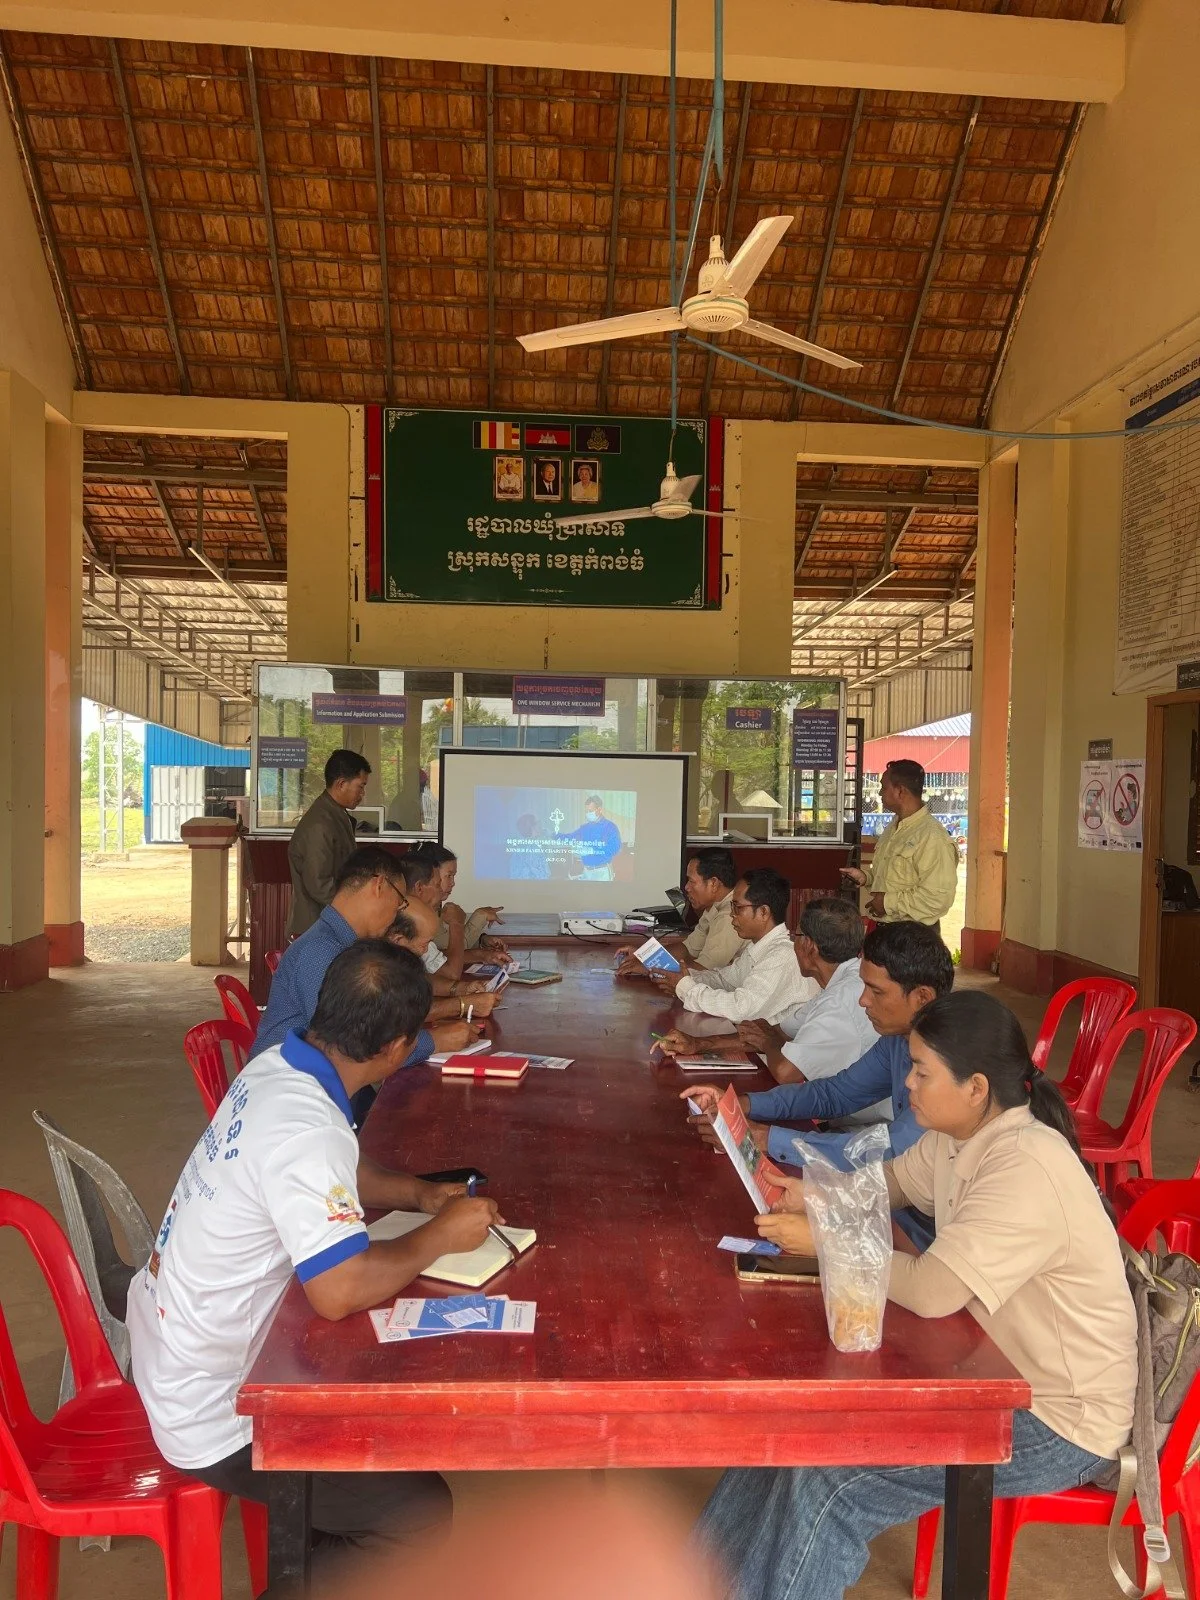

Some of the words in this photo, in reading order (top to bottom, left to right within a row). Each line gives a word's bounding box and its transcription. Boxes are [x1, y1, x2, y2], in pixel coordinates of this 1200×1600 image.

[447, 550, 541, 580] ស្រុកសន្ទុក
[546, 547, 645, 576] ខេត្តកំពង់ធំ
[316, 709, 343, 717] Information
[735, 720, 763, 729] Cashier
